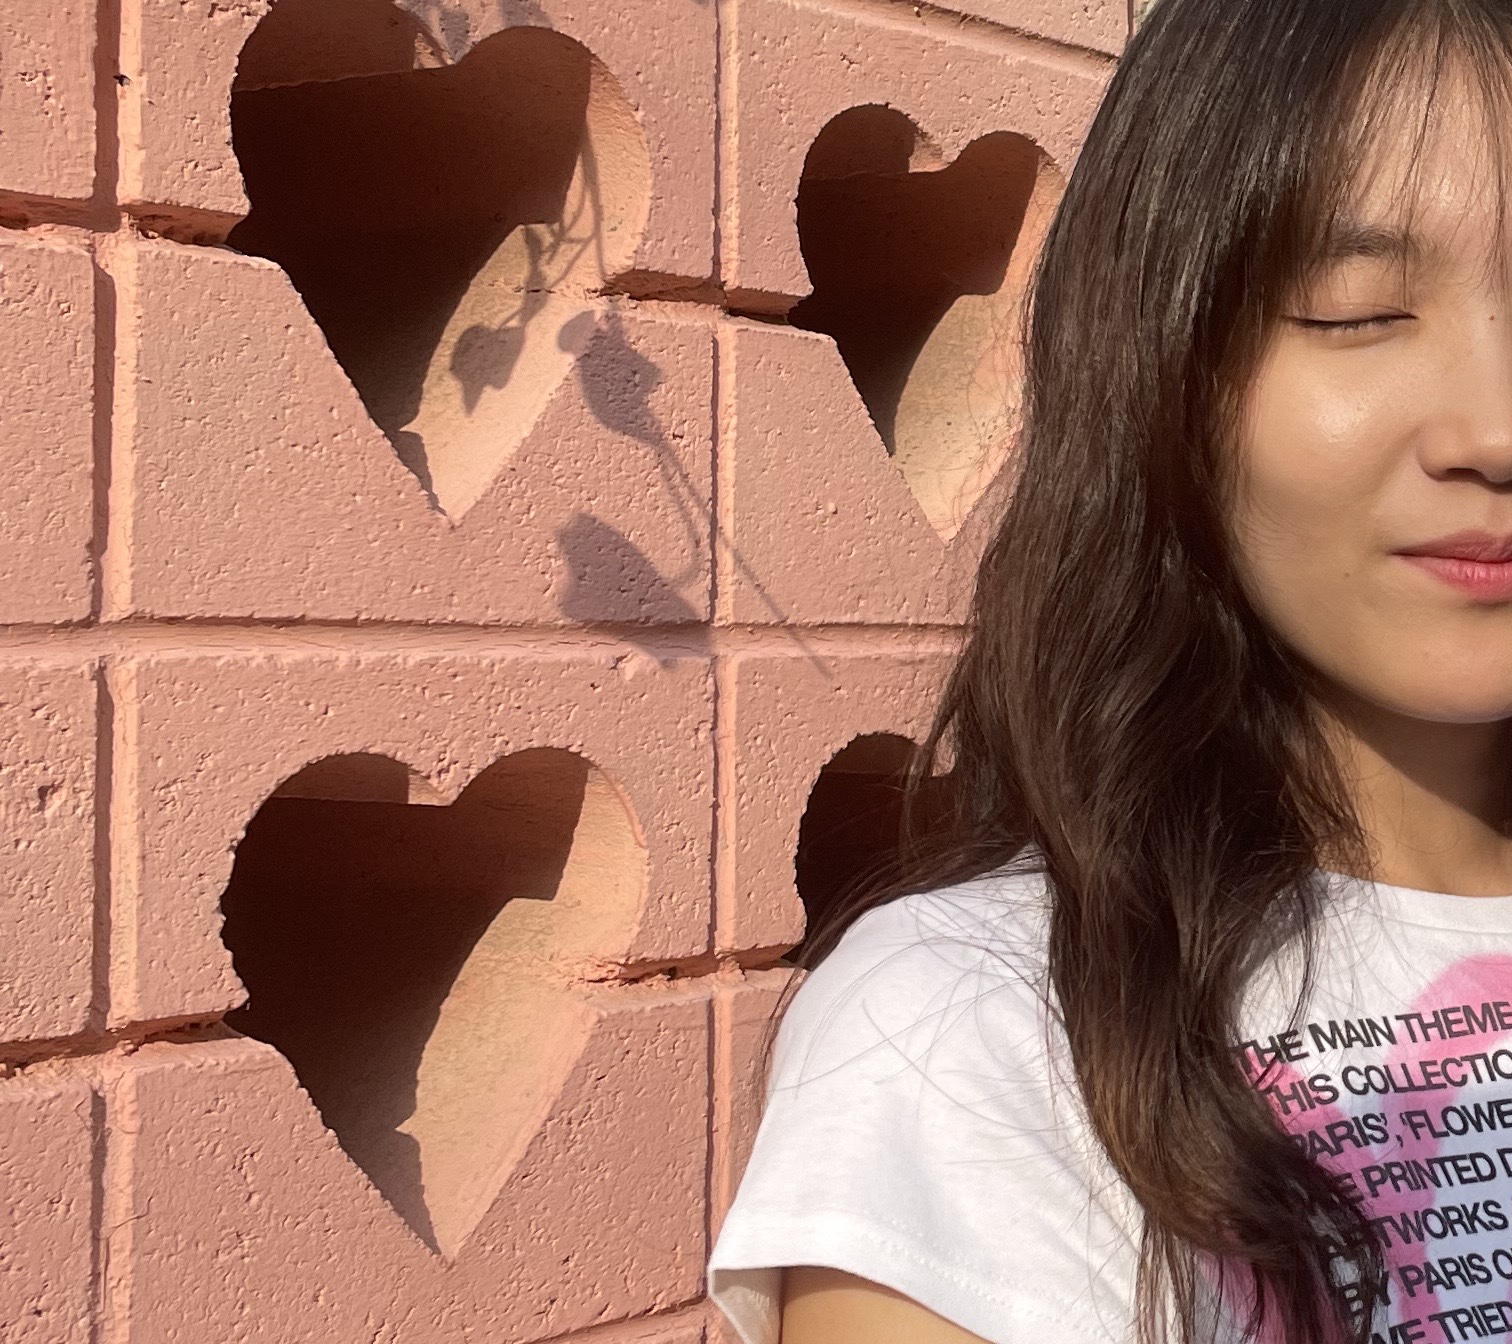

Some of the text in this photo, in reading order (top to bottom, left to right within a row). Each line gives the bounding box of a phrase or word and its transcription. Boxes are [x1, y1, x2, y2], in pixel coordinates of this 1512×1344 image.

[1232, 1029, 1310, 1074] THE
[1308, 1016, 1397, 1053] MAIN
[1260, 1074, 1340, 1115] HIS
[1362, 1151, 1497, 1199] PRINTED
[1398, 1252, 1492, 1298] PARIS
